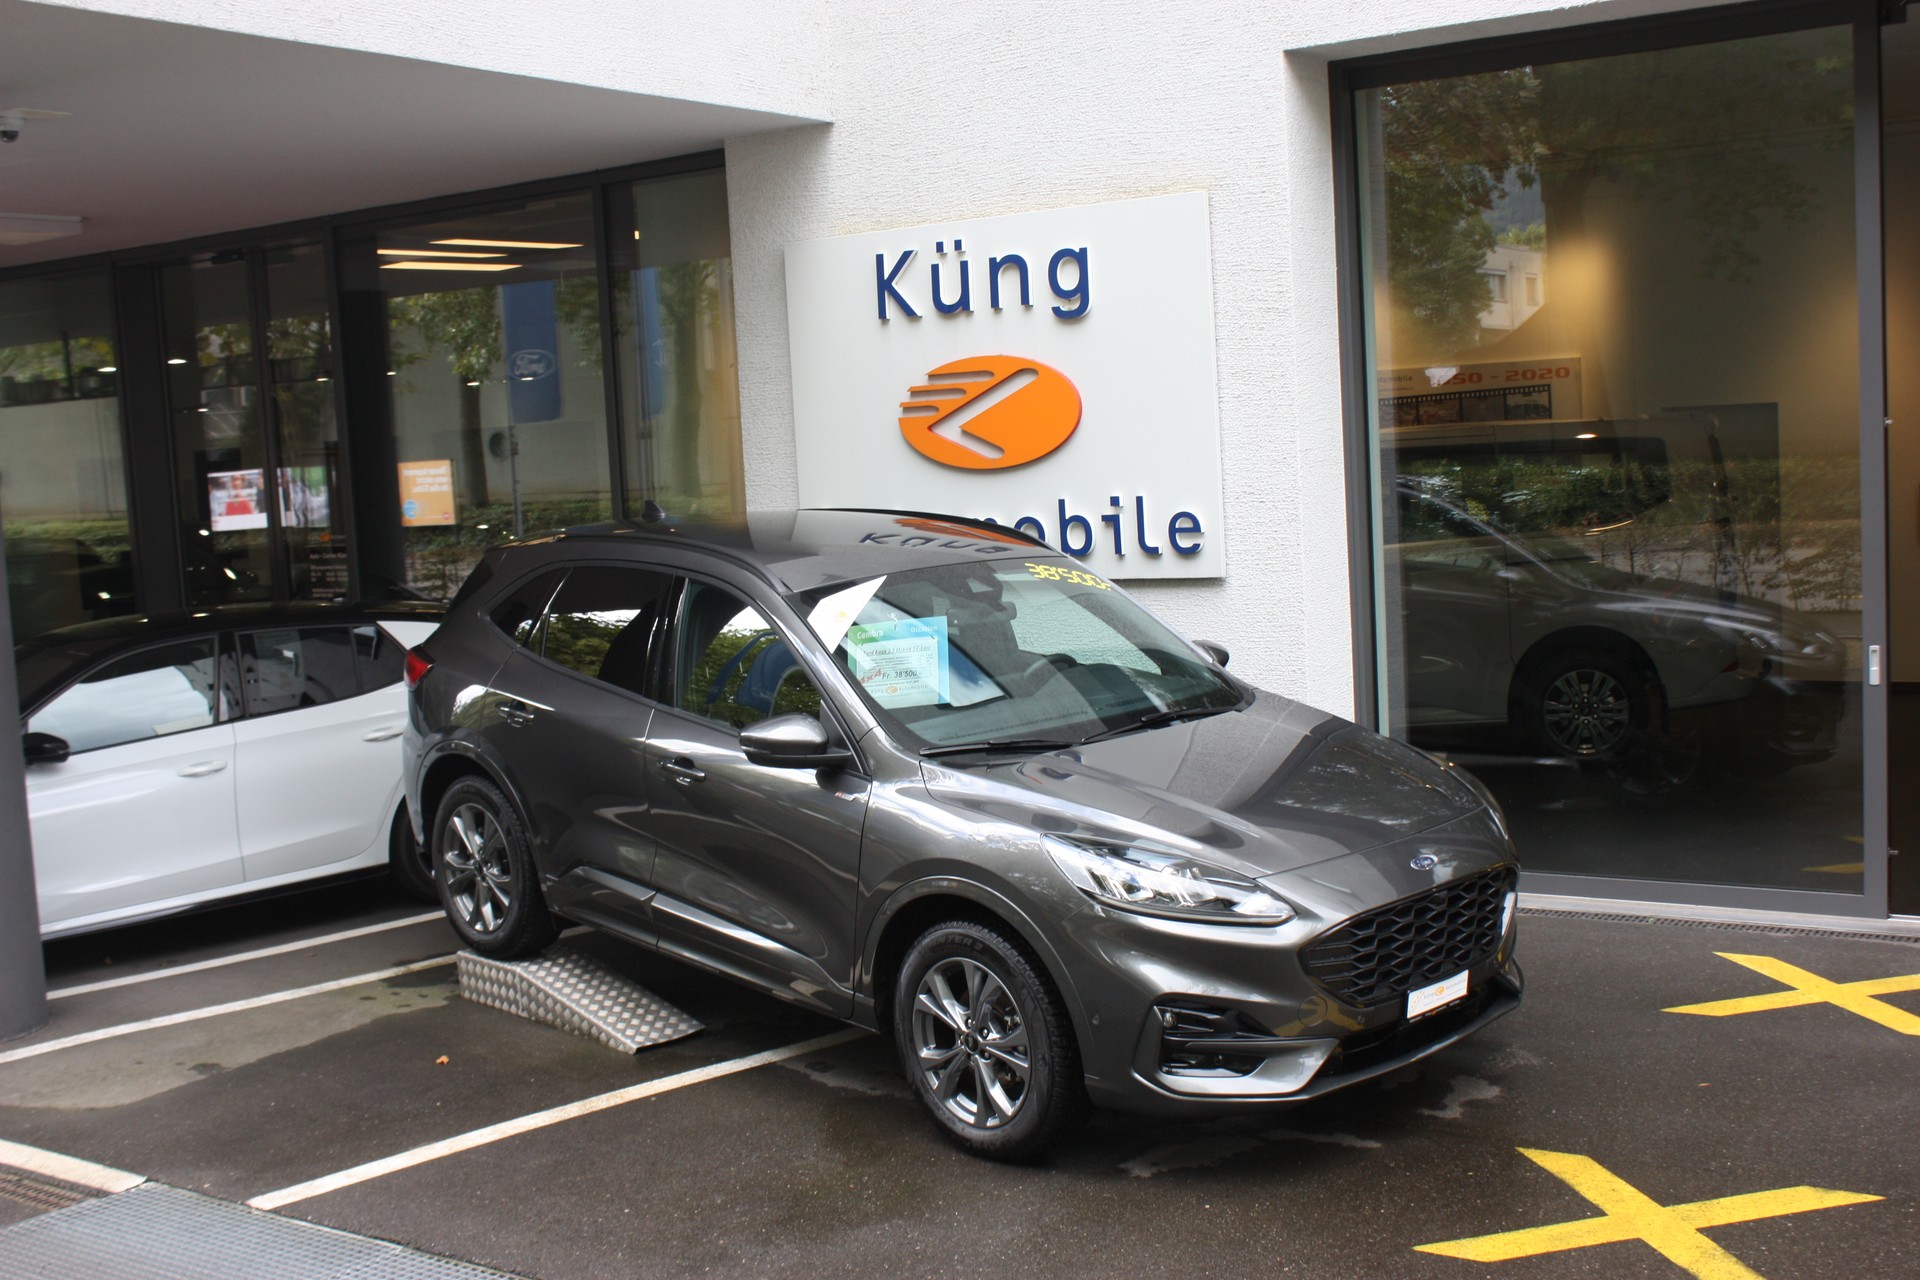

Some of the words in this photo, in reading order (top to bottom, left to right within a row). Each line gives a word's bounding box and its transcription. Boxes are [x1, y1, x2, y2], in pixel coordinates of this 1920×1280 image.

[876, 239, 1090, 320] Küng
[1505, 367, 1570, 382] 2020
[983, 495, 1206, 558] obile
[857, 629, 884, 639] Cembra
[911, 625, 937, 633] Occasion
